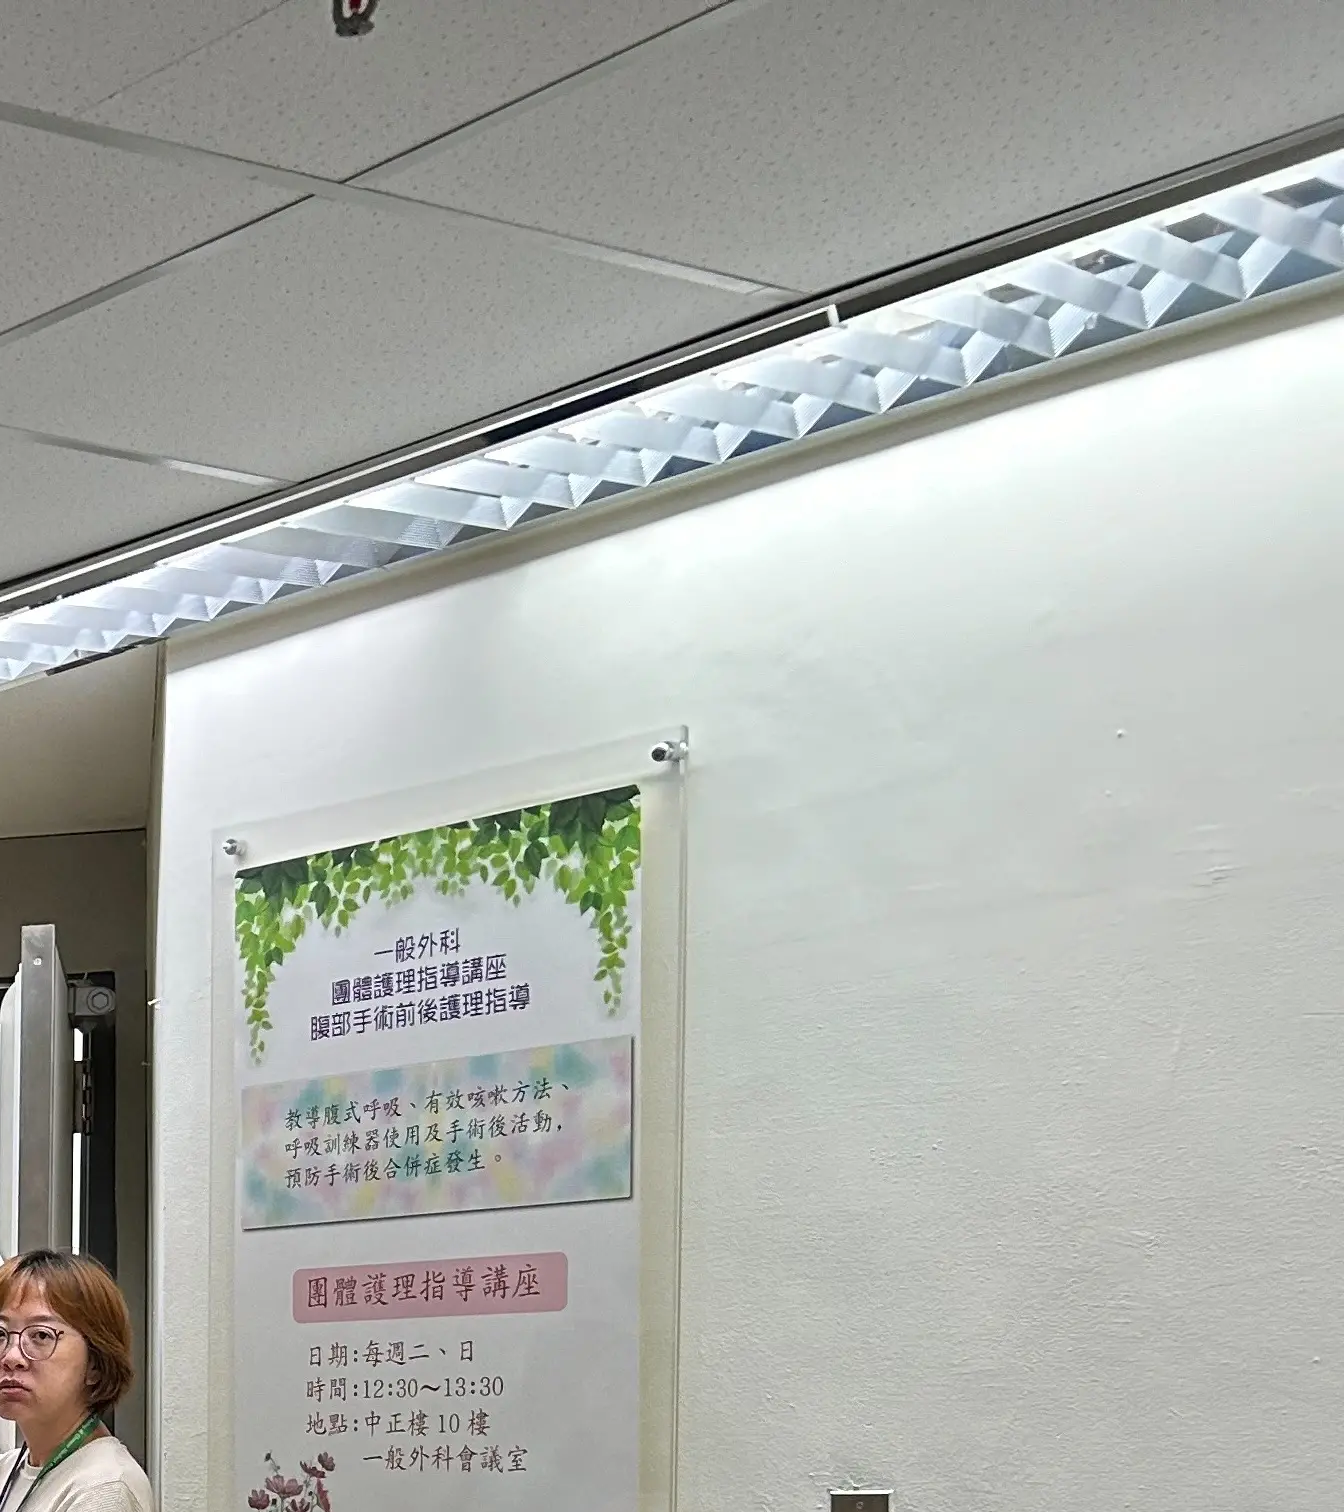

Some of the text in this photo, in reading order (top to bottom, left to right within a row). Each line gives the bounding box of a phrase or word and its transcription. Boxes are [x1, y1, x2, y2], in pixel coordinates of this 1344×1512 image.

[374, 927, 460, 963] 一般外科
[332, 954, 507, 1006] 團體護理指導講座
[311, 983, 530, 1041] 腹部手術前後護理指導
[307, 1264, 541, 1308] 團體護理指導講座
[363, 1445, 528, 1473] 一般外科會議室
